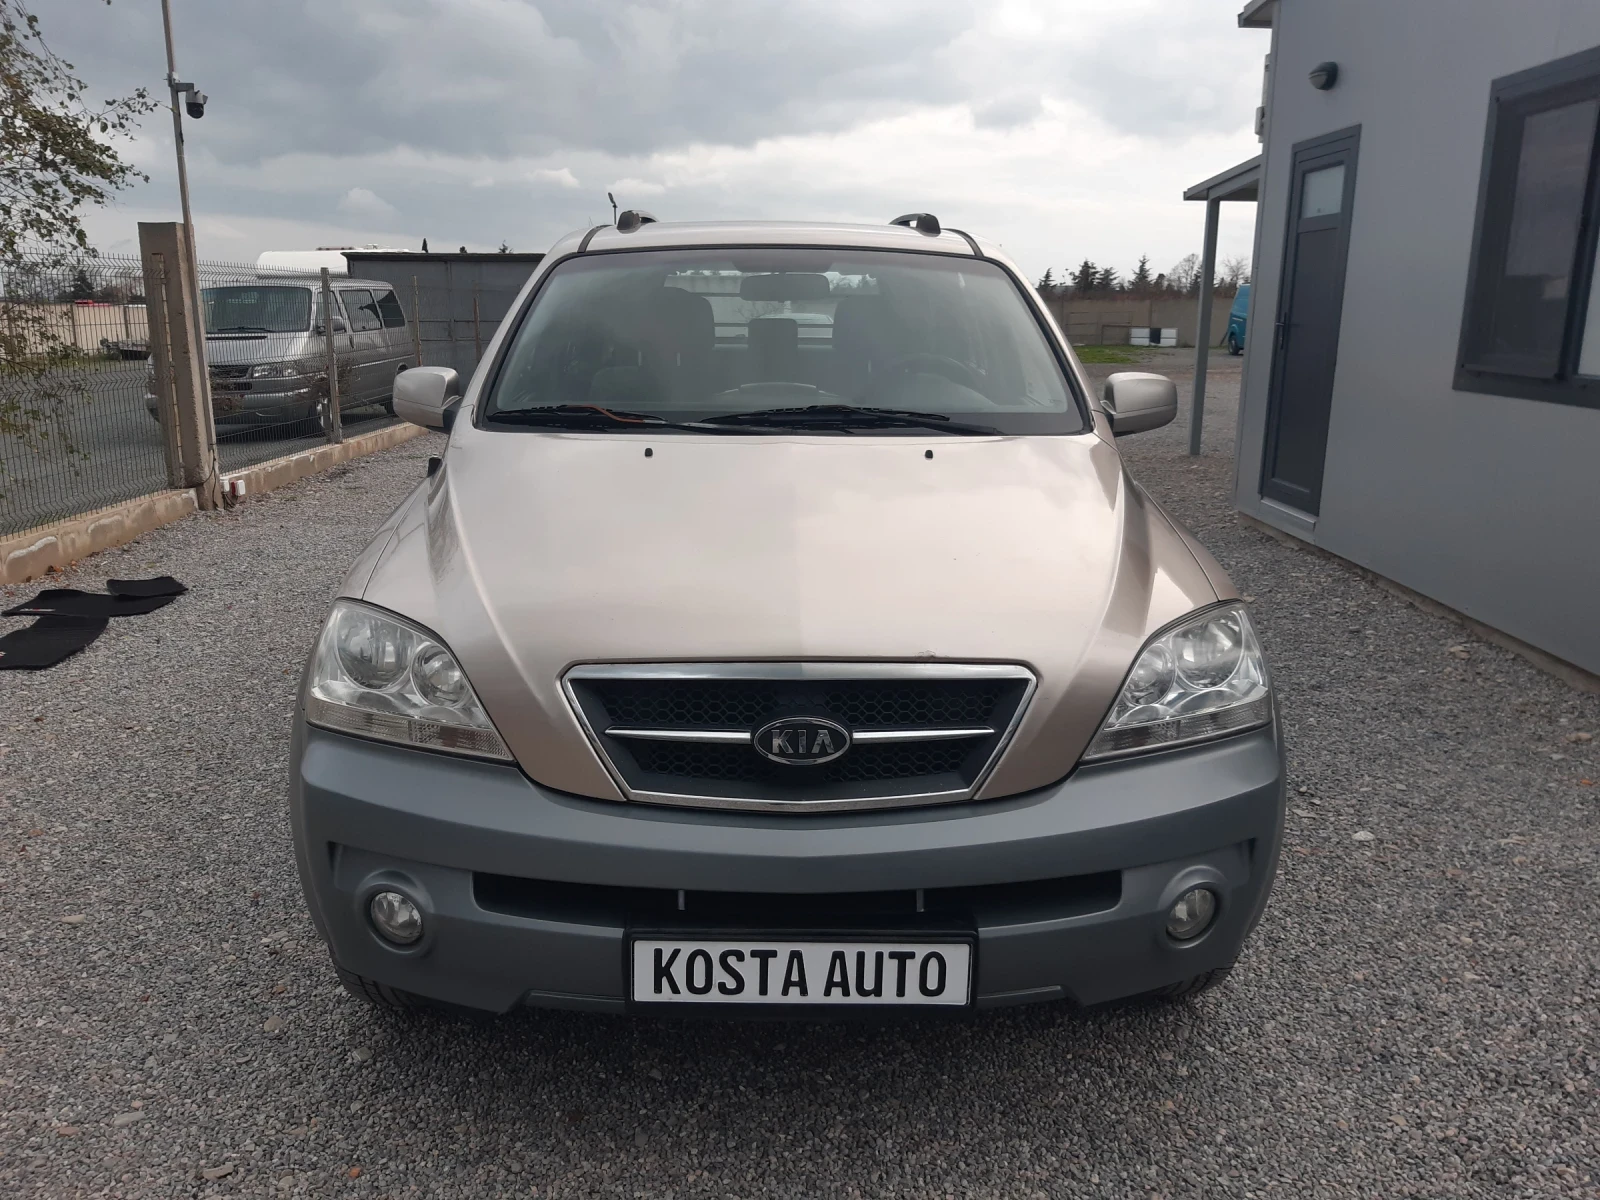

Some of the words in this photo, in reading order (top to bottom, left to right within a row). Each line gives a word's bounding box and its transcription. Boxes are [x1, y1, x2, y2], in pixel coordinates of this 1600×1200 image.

[771, 729, 835, 754] KIA
[653, 947, 809, 997] KOSTA
[823, 950, 947, 998] AUTO
